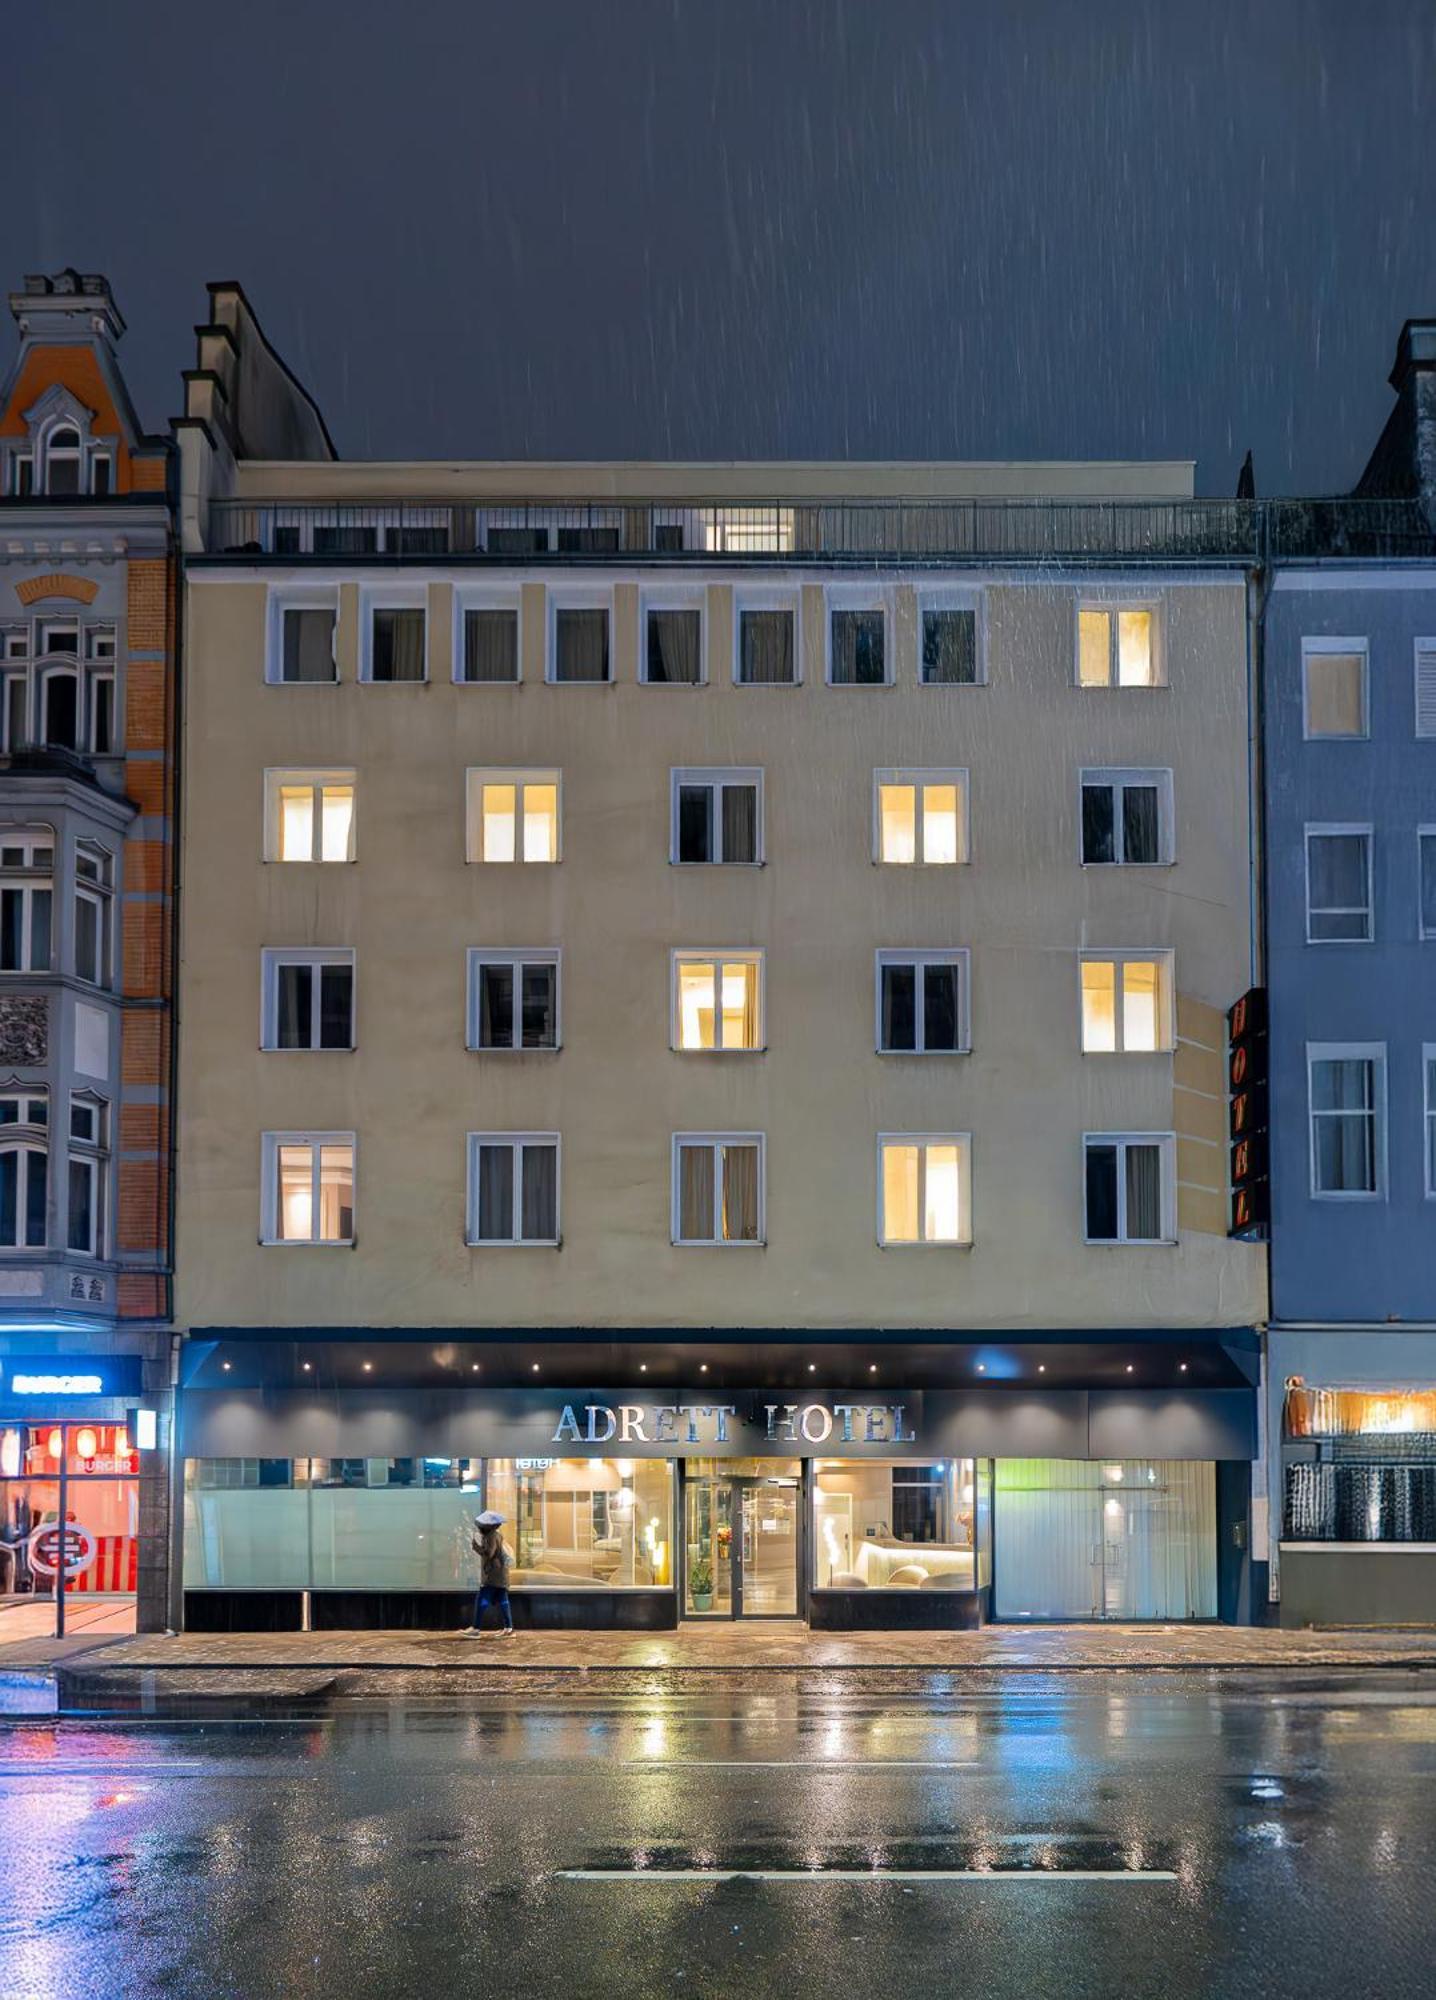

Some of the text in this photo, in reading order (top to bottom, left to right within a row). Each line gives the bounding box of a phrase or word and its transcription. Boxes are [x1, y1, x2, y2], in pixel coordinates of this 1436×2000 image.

[1232, 997, 1249, 1226] HOTEL
[551, 1404, 916, 1442] ADRETT HOTEL
